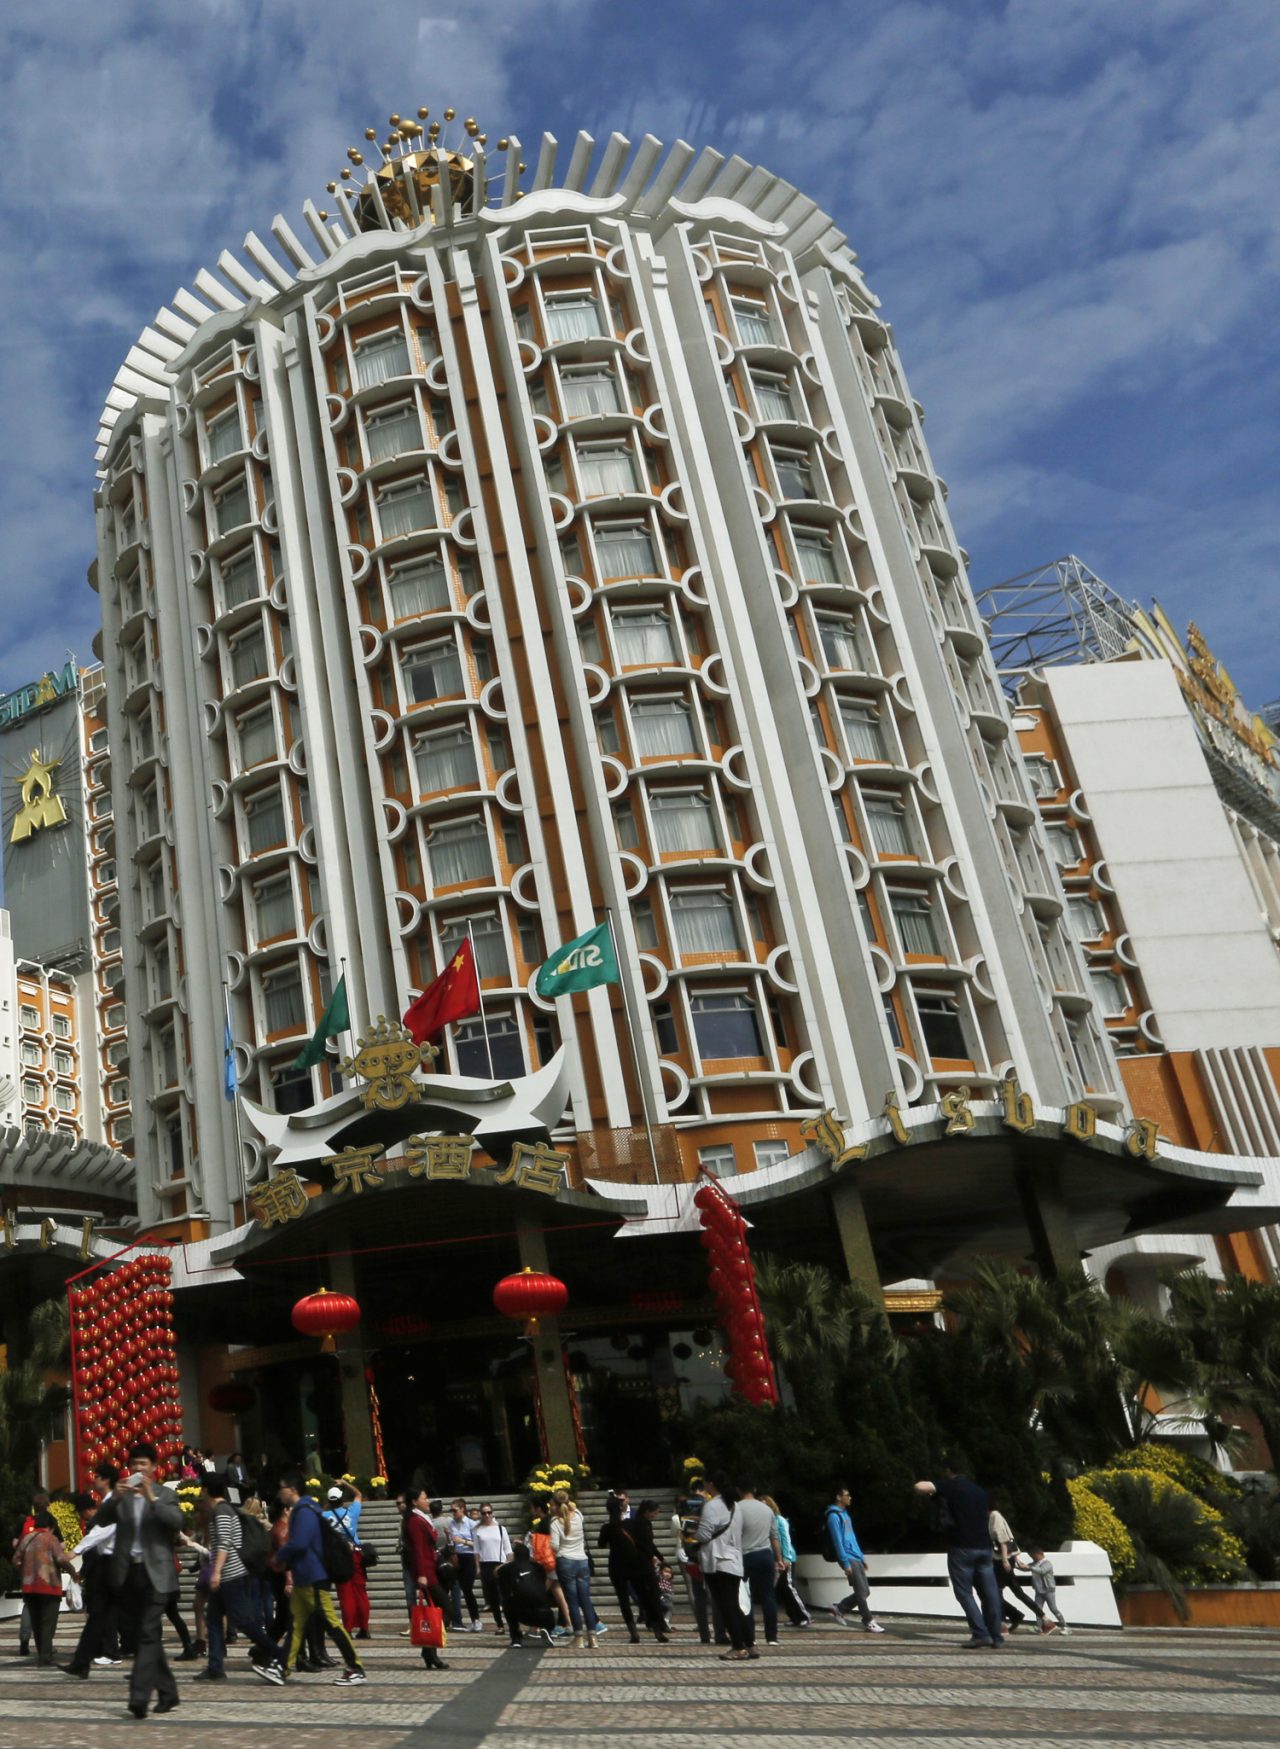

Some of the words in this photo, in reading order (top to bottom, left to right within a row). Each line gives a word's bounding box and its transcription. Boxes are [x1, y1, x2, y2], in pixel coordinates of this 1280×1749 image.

[799, 1077, 1161, 1172] Lisboa
[246, 1134, 572, 1230] 葡京酒店
